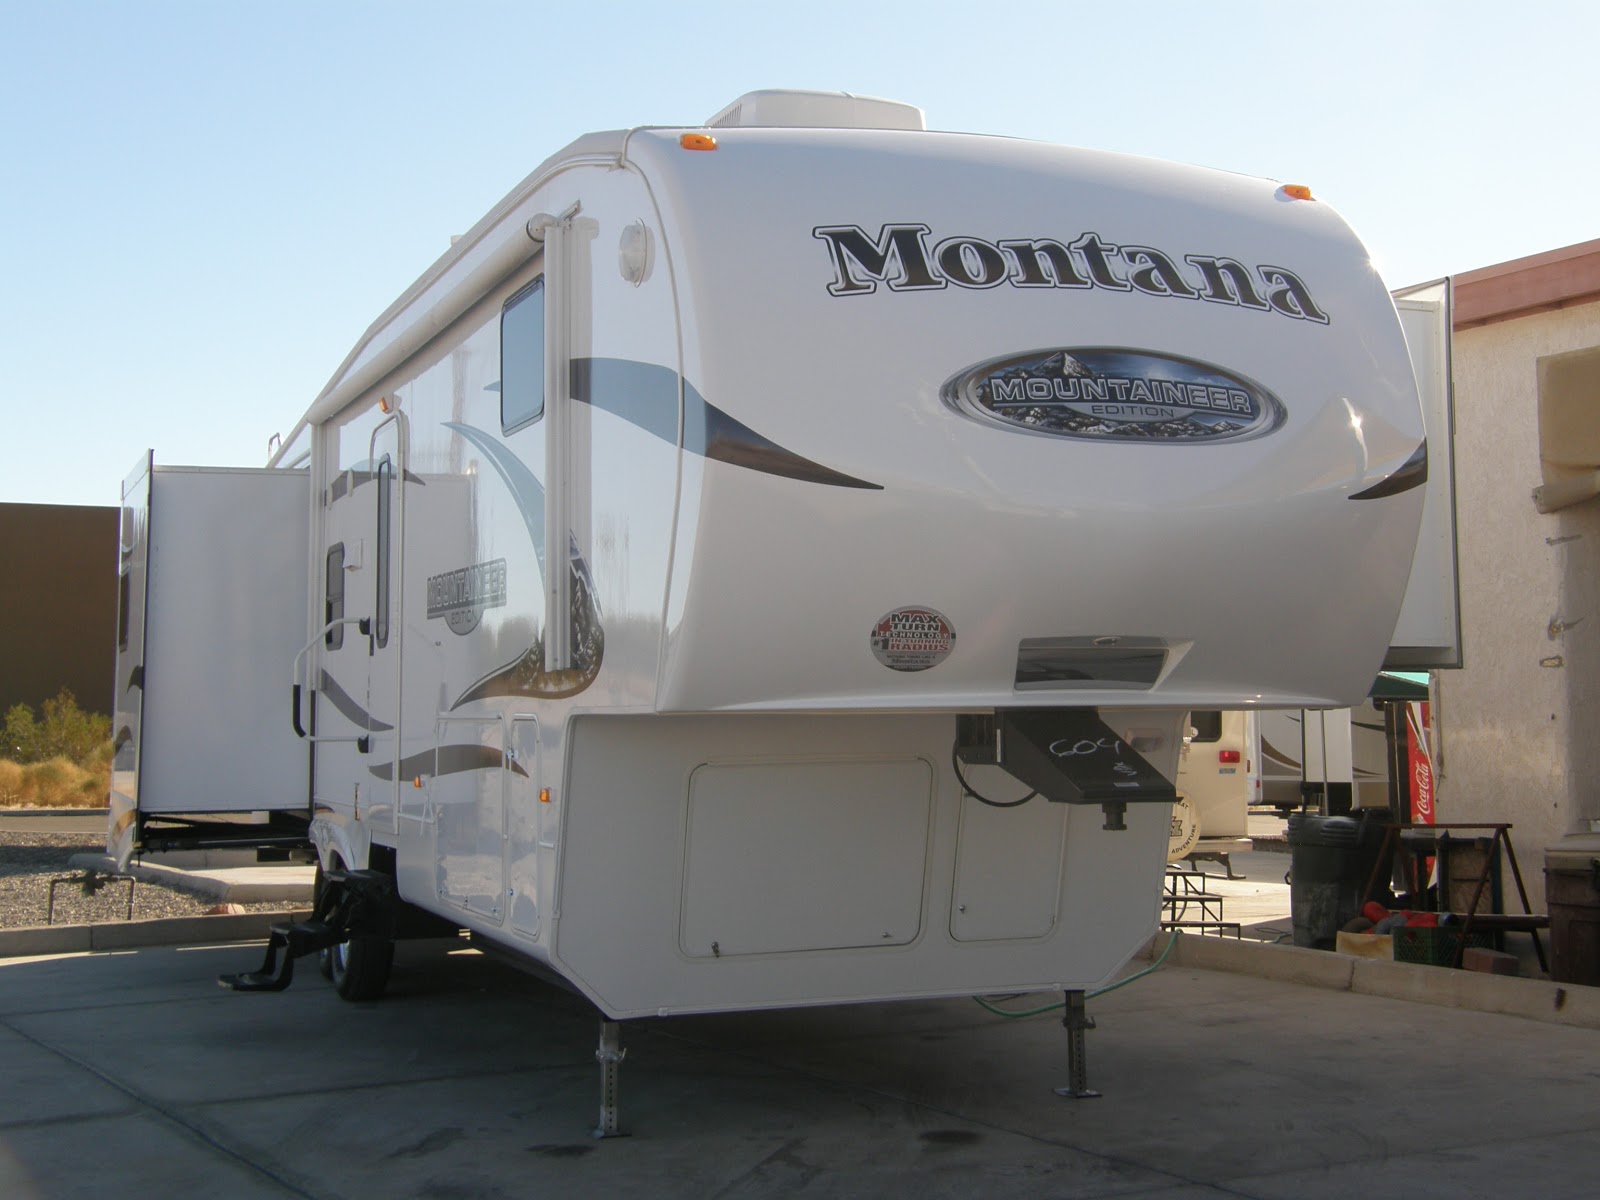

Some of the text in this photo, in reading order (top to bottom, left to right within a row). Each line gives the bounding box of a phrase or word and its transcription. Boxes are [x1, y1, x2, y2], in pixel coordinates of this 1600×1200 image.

[813, 224, 1330, 325] Montana
[991, 378, 1251, 413] MOUNTAINEER
[1092, 404, 1174, 418] EDITION
[427, 562, 506, 608] MOUNTAINEER
[891, 613, 939, 623] MAX
[892, 623, 940, 631] TURN
[890, 643, 949, 651] RADIUS
[1171, 824, 1196, 854] ADVENTURE
